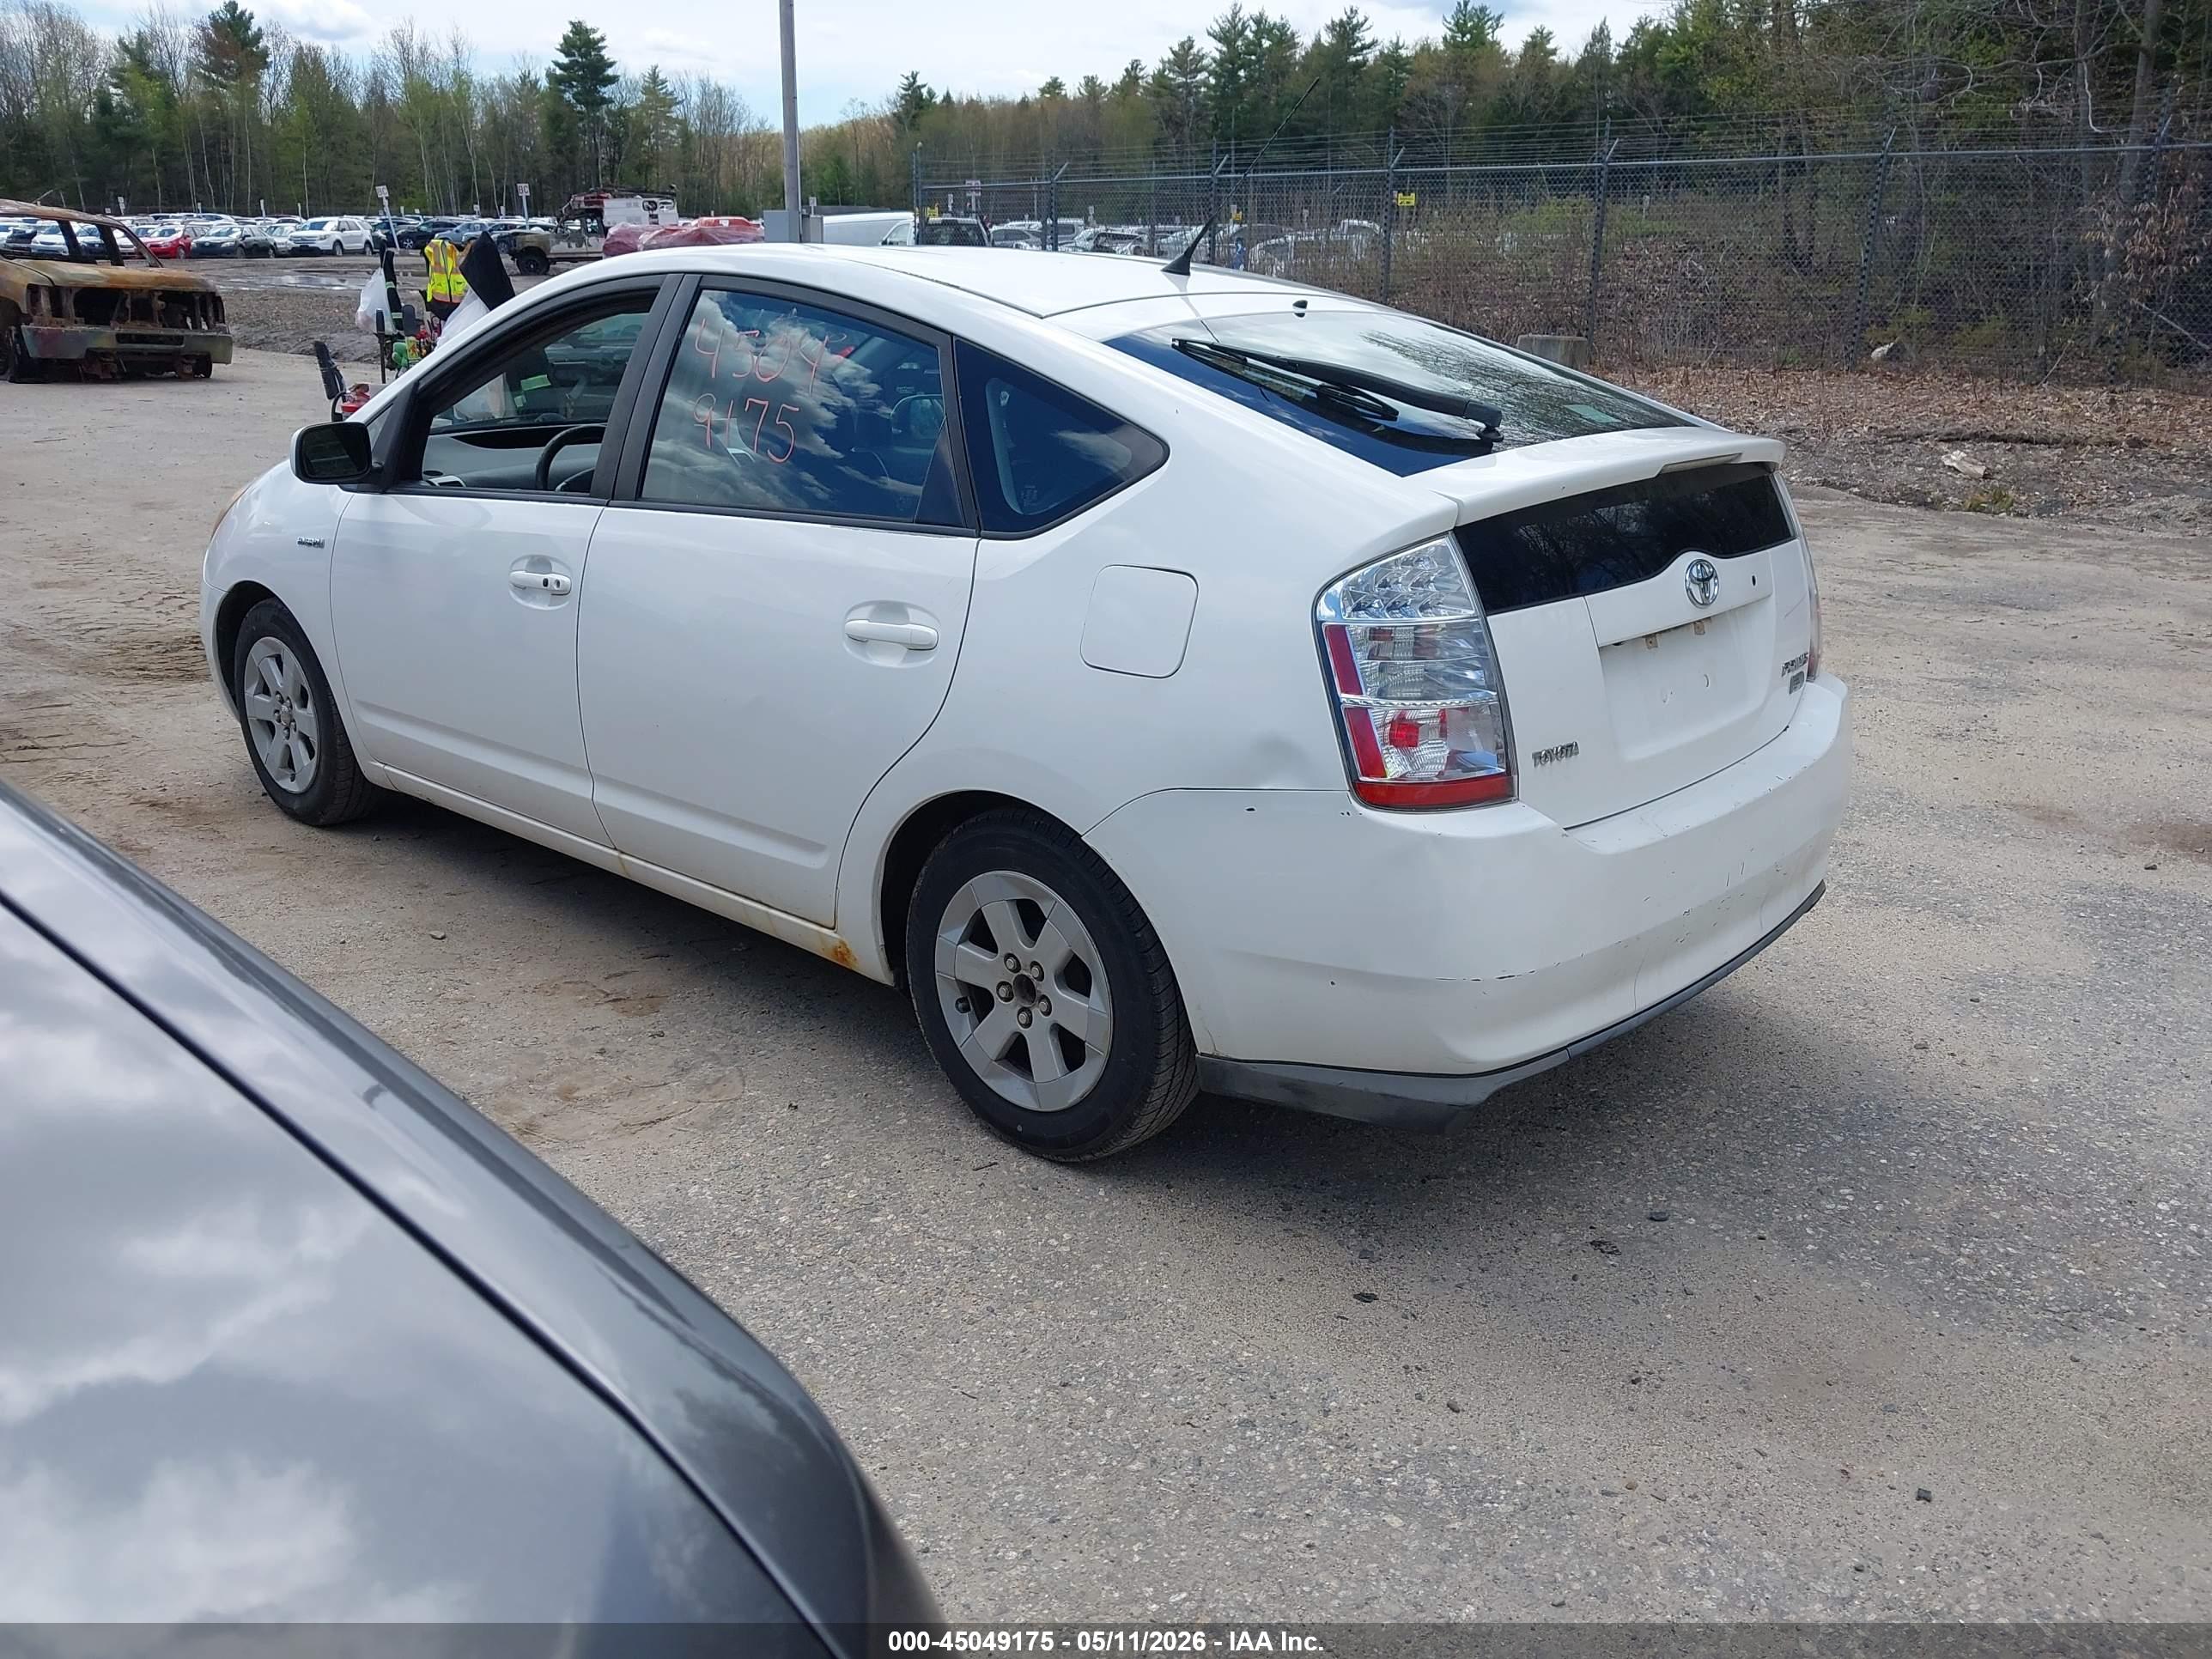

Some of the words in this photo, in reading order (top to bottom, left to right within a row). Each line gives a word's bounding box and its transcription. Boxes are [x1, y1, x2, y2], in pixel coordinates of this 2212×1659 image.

[695, 318, 830, 396] 4504
[693, 392, 800, 463] 9175
[1531, 740, 1580, 769] TOYOTA
